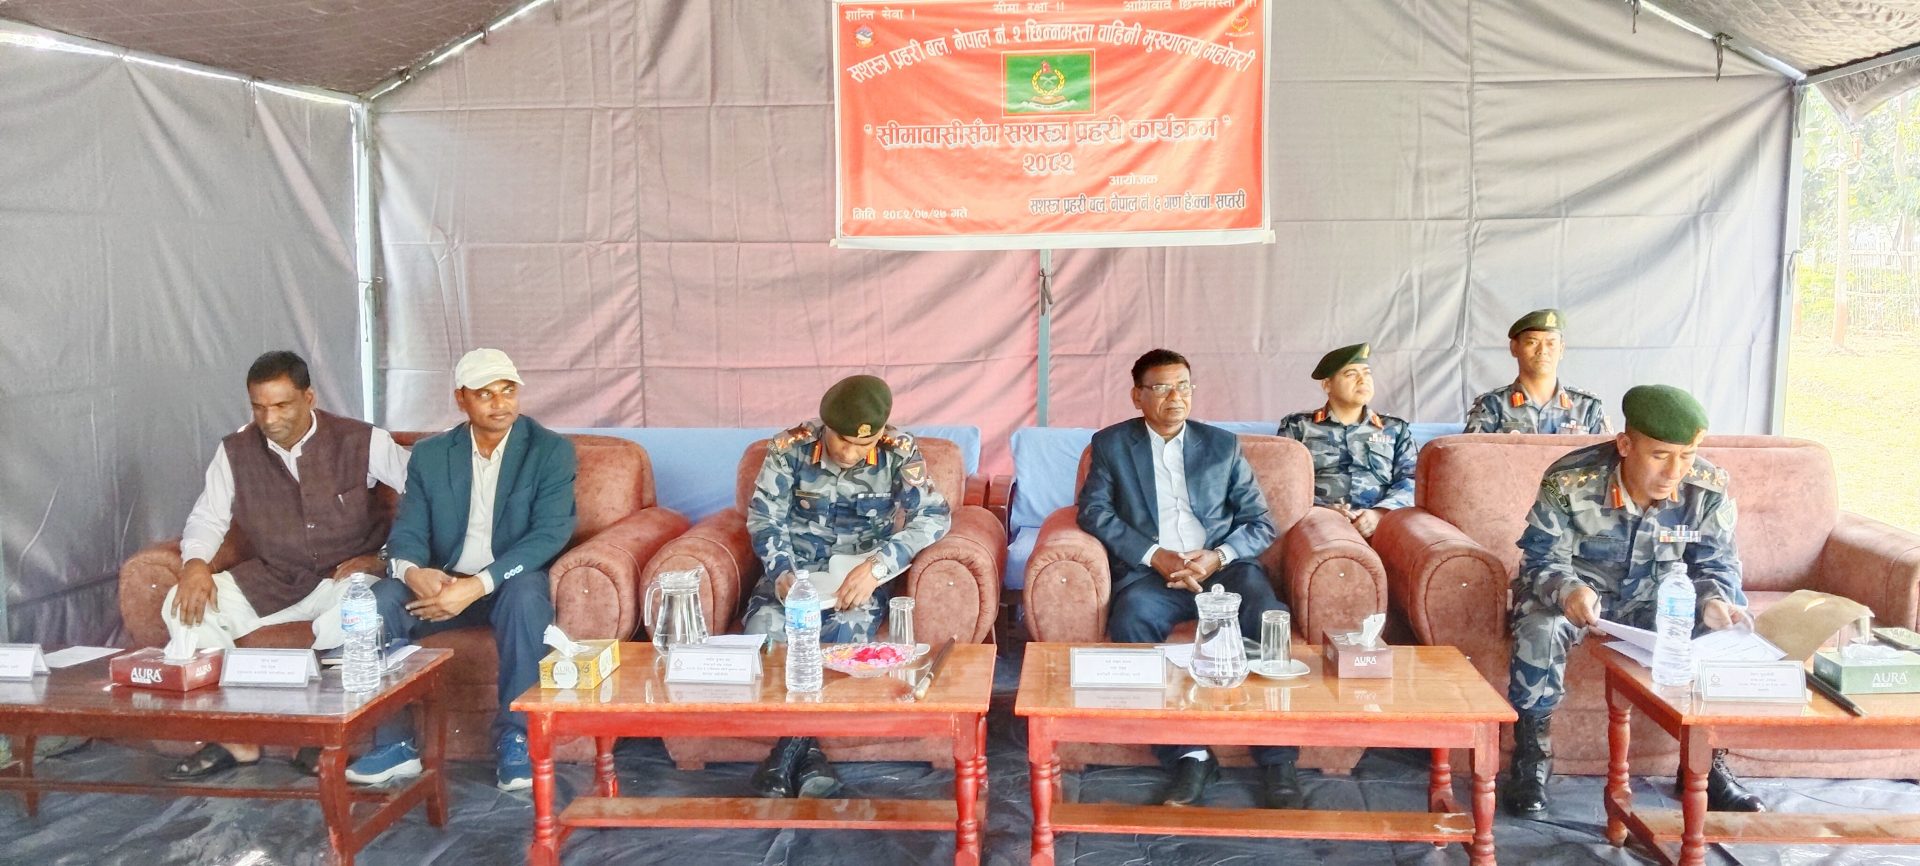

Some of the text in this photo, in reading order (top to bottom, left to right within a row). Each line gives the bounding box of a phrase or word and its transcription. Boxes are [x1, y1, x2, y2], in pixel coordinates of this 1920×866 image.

[845, 8, 875, 21] शान्ति
[846, 53, 892, 83] सशस्त्र
[888, 38, 926, 70] प्रहरी
[952, 28, 991, 50] नेपाल
[1025, 18, 1095, 43] छिन्नमस्ता
[1098, 20, 1142, 46] वाहिनी
[1004, 121, 1070, 148] सशस्त्र
[1074, 115, 1124, 145] प्रहरी
[1128, 113, 1218, 142] कार्यक्रम
[1023, 152, 1075, 176] २०८२
[1063, 193, 1088, 214] प्रहरी
[1110, 192, 1138, 212] नेपाल
[852, 208, 876, 220] मिति
[1354, 656, 1377, 665] AURA
[131, 667, 163, 683] AURA
[1872, 671, 1908, 685] AURA
